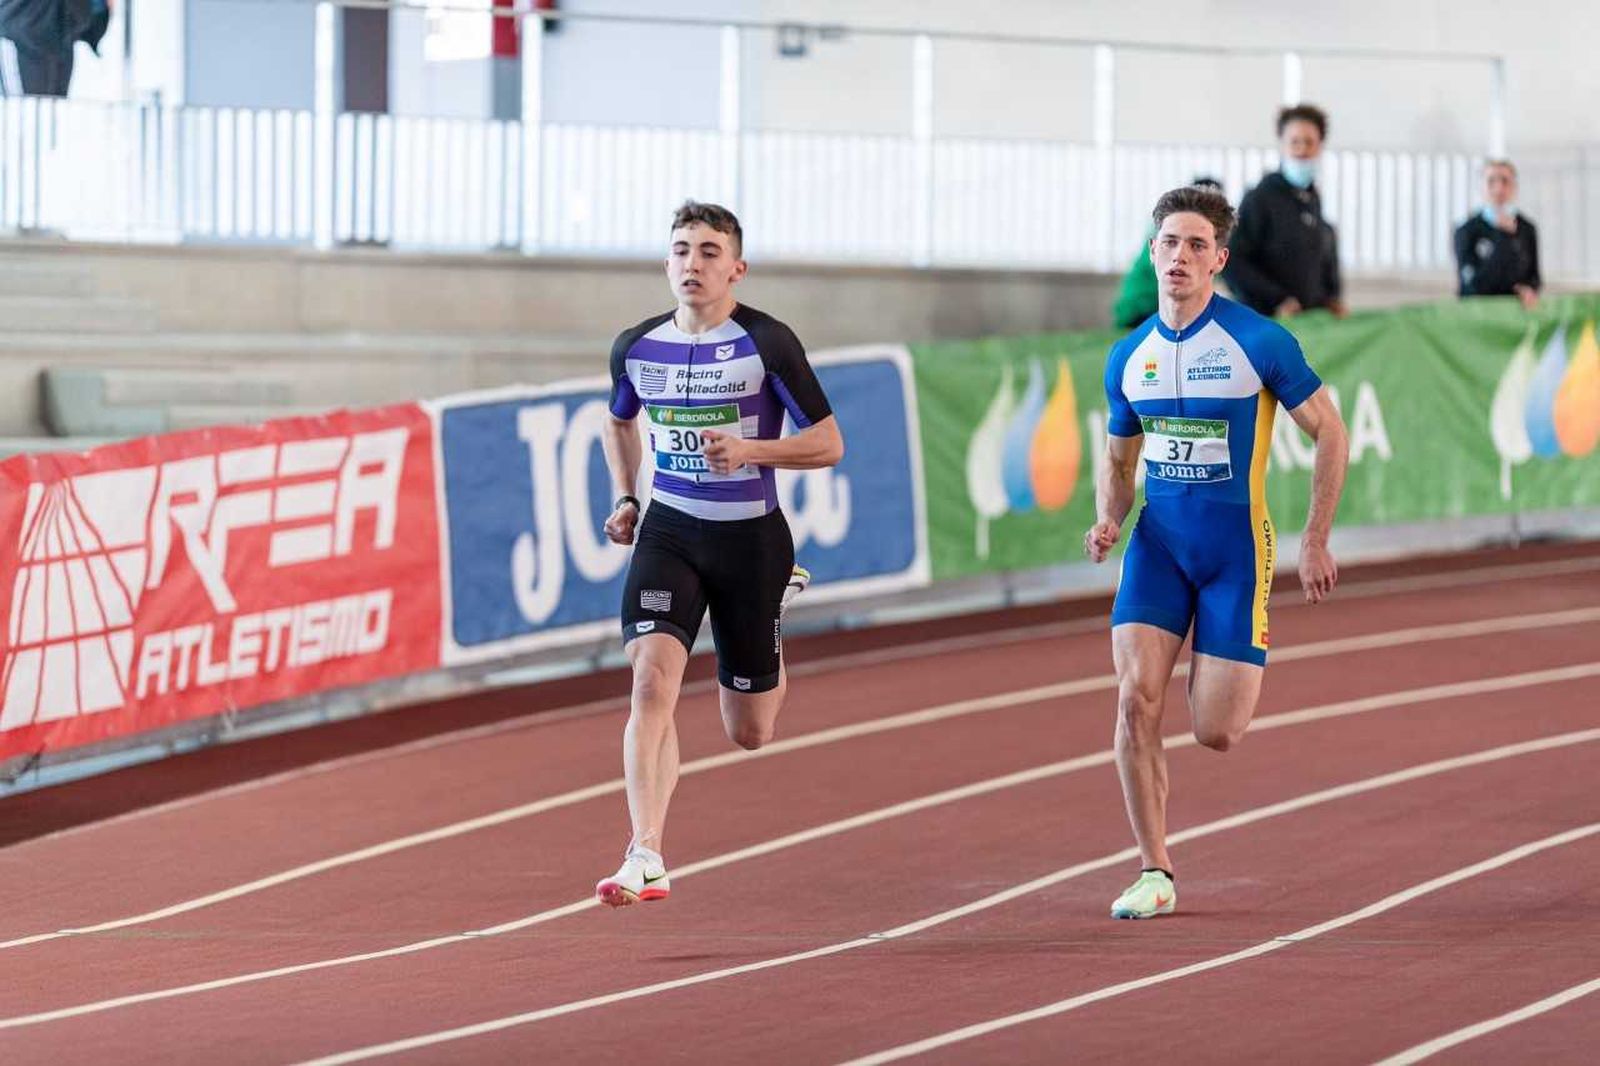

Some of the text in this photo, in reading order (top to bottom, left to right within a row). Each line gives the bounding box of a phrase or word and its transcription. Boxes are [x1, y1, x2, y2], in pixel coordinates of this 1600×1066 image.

[676, 369, 723, 380] Racing
[1187, 366, 1231, 374] ATLETISMO
[676, 381, 746, 394] Valladolid
[674, 412, 725, 422] IBERDROLA
[1167, 422, 1215, 434] IBERDROLA
[670, 430, 706, 452] 30
[1167, 440, 1194, 462] 37
[670, 456, 710, 470] Jom
[135, 590, 393, 699] ATLETISMO
